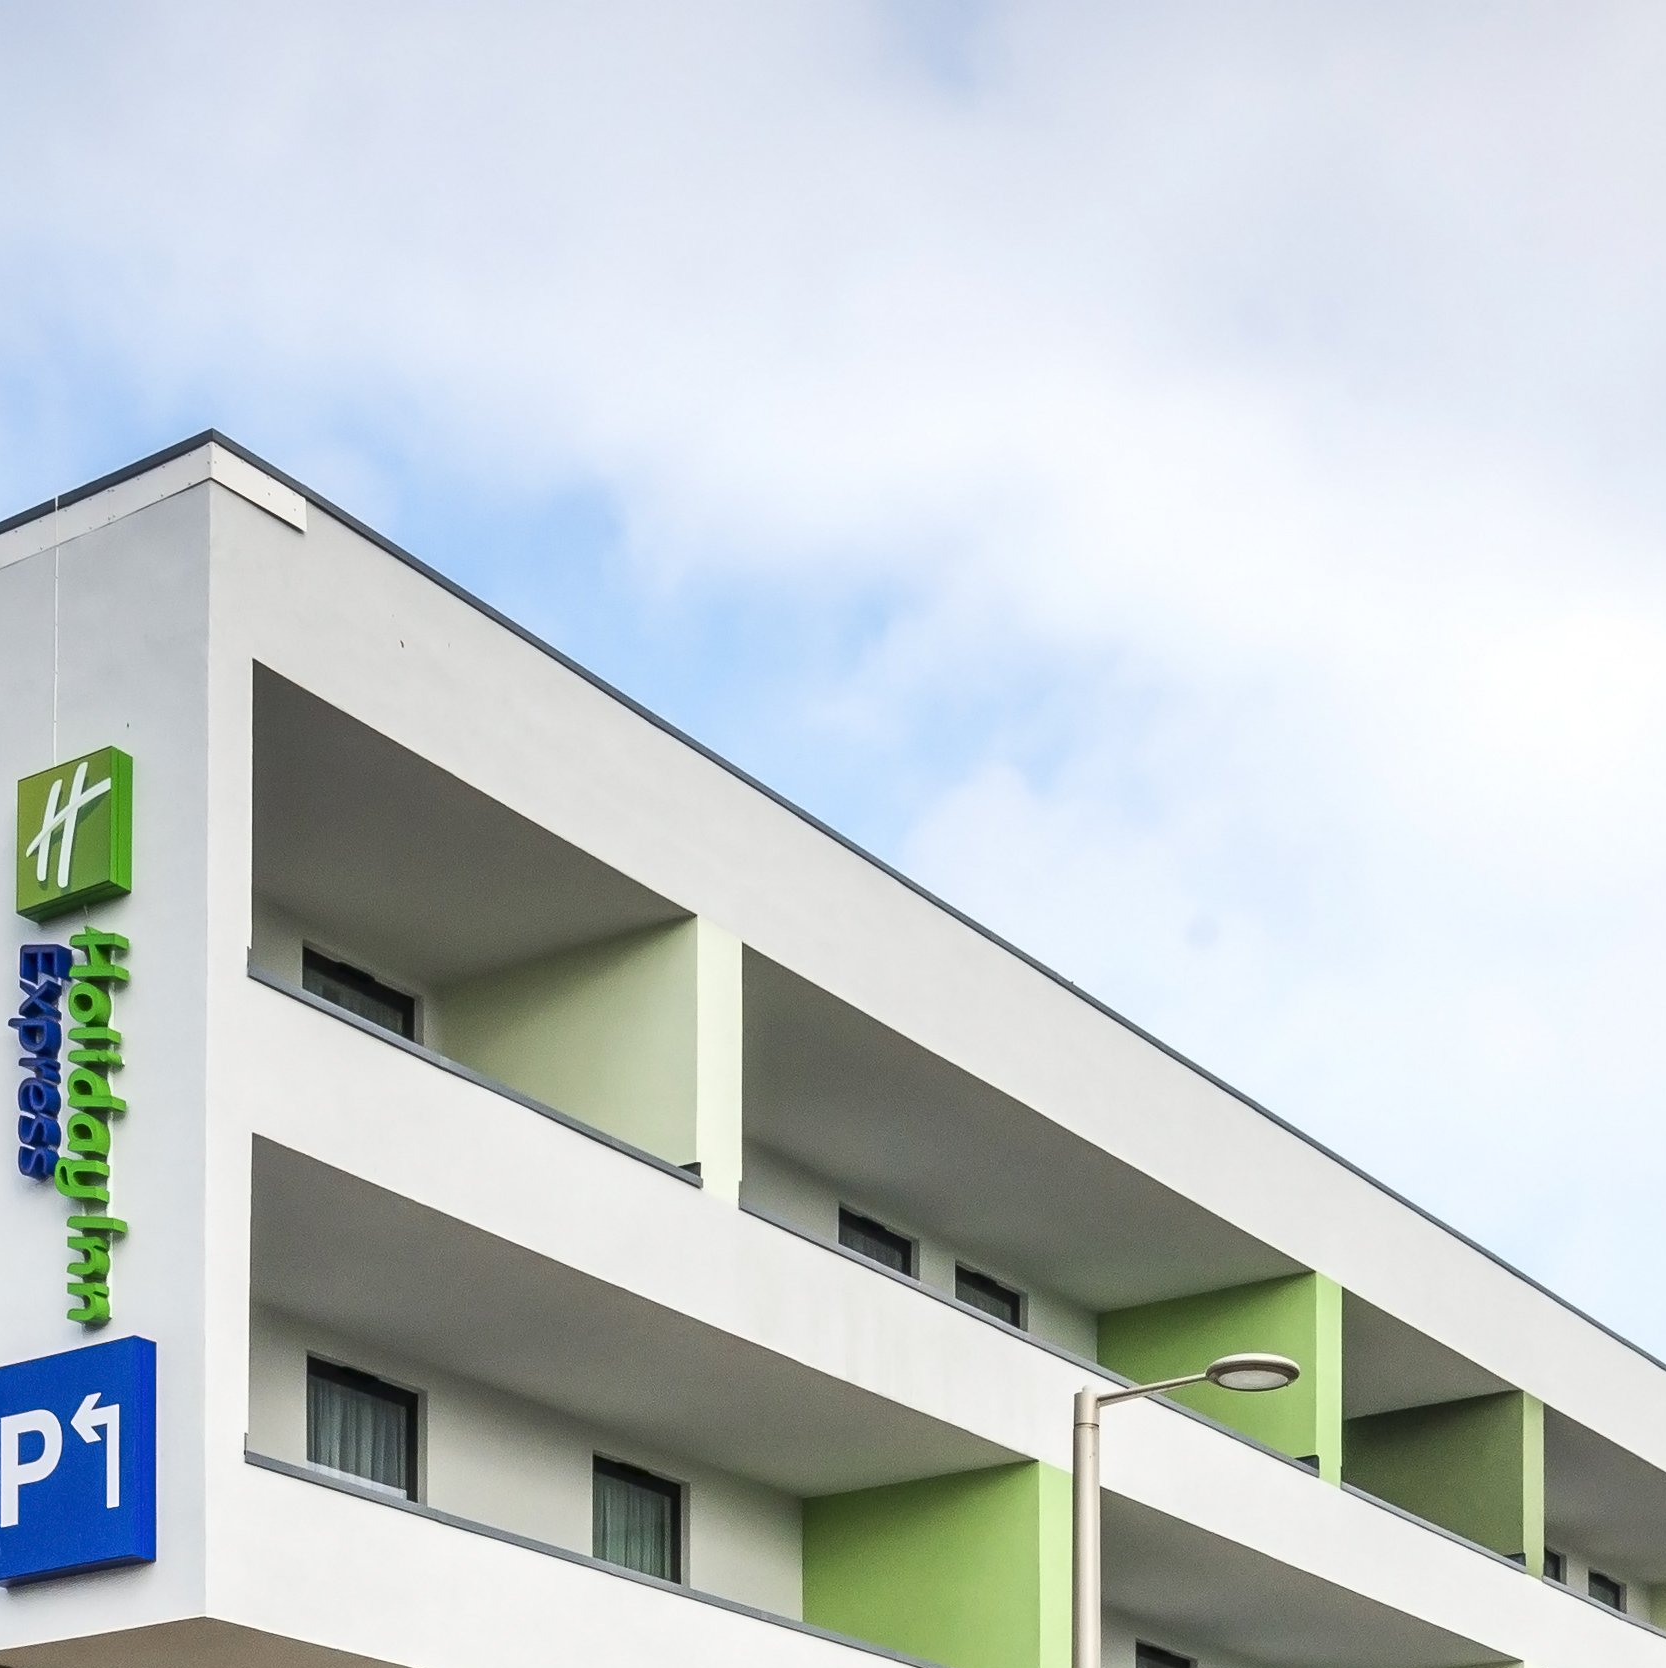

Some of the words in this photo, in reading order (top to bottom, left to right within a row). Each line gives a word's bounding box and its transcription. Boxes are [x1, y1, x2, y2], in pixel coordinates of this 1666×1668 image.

[8, 942, 72, 1185] Express
[54, 925, 130, 1202] Holiday
[66, 1215, 128, 1328] Inn
[0, 1407, 63, 1530] P
